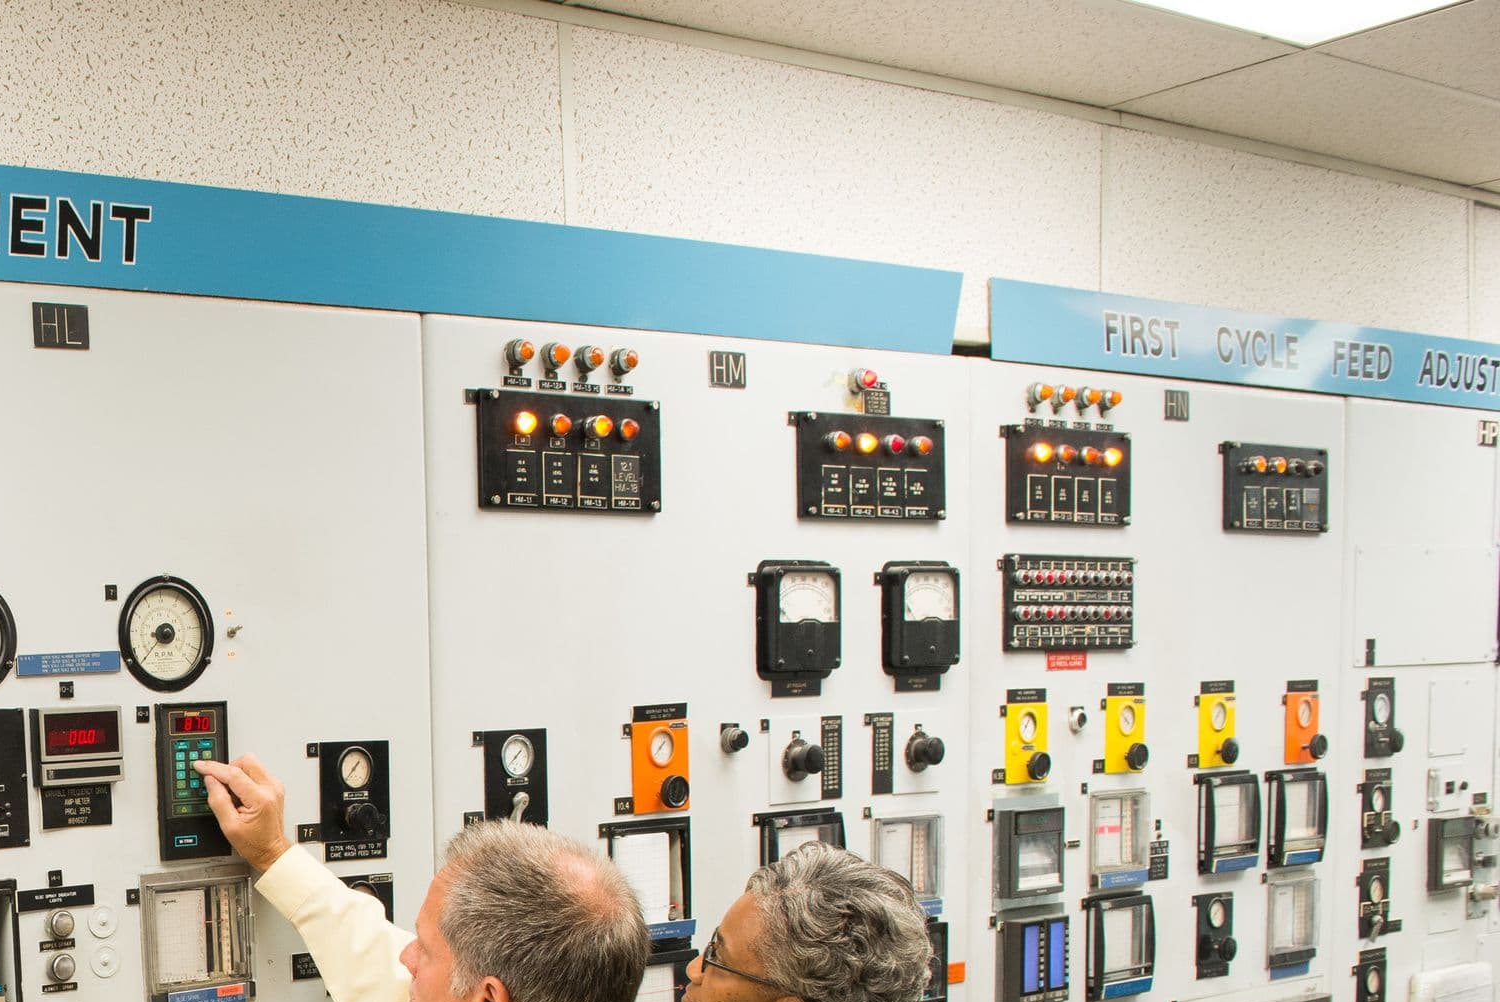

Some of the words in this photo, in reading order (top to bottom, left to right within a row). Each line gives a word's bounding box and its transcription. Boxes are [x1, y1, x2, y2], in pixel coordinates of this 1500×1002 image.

[40, 306, 82, 345] HL
[1103, 311, 1182, 361] FIRST
[1216, 326, 1299, 371] CYCLE
[1332, 340, 1393, 382] FEED
[714, 354, 744, 385] HM
[1167, 391, 1188, 419] HN
[1479, 421, 1498, 445] HP
[614, 473, 638, 483] LEVEL
